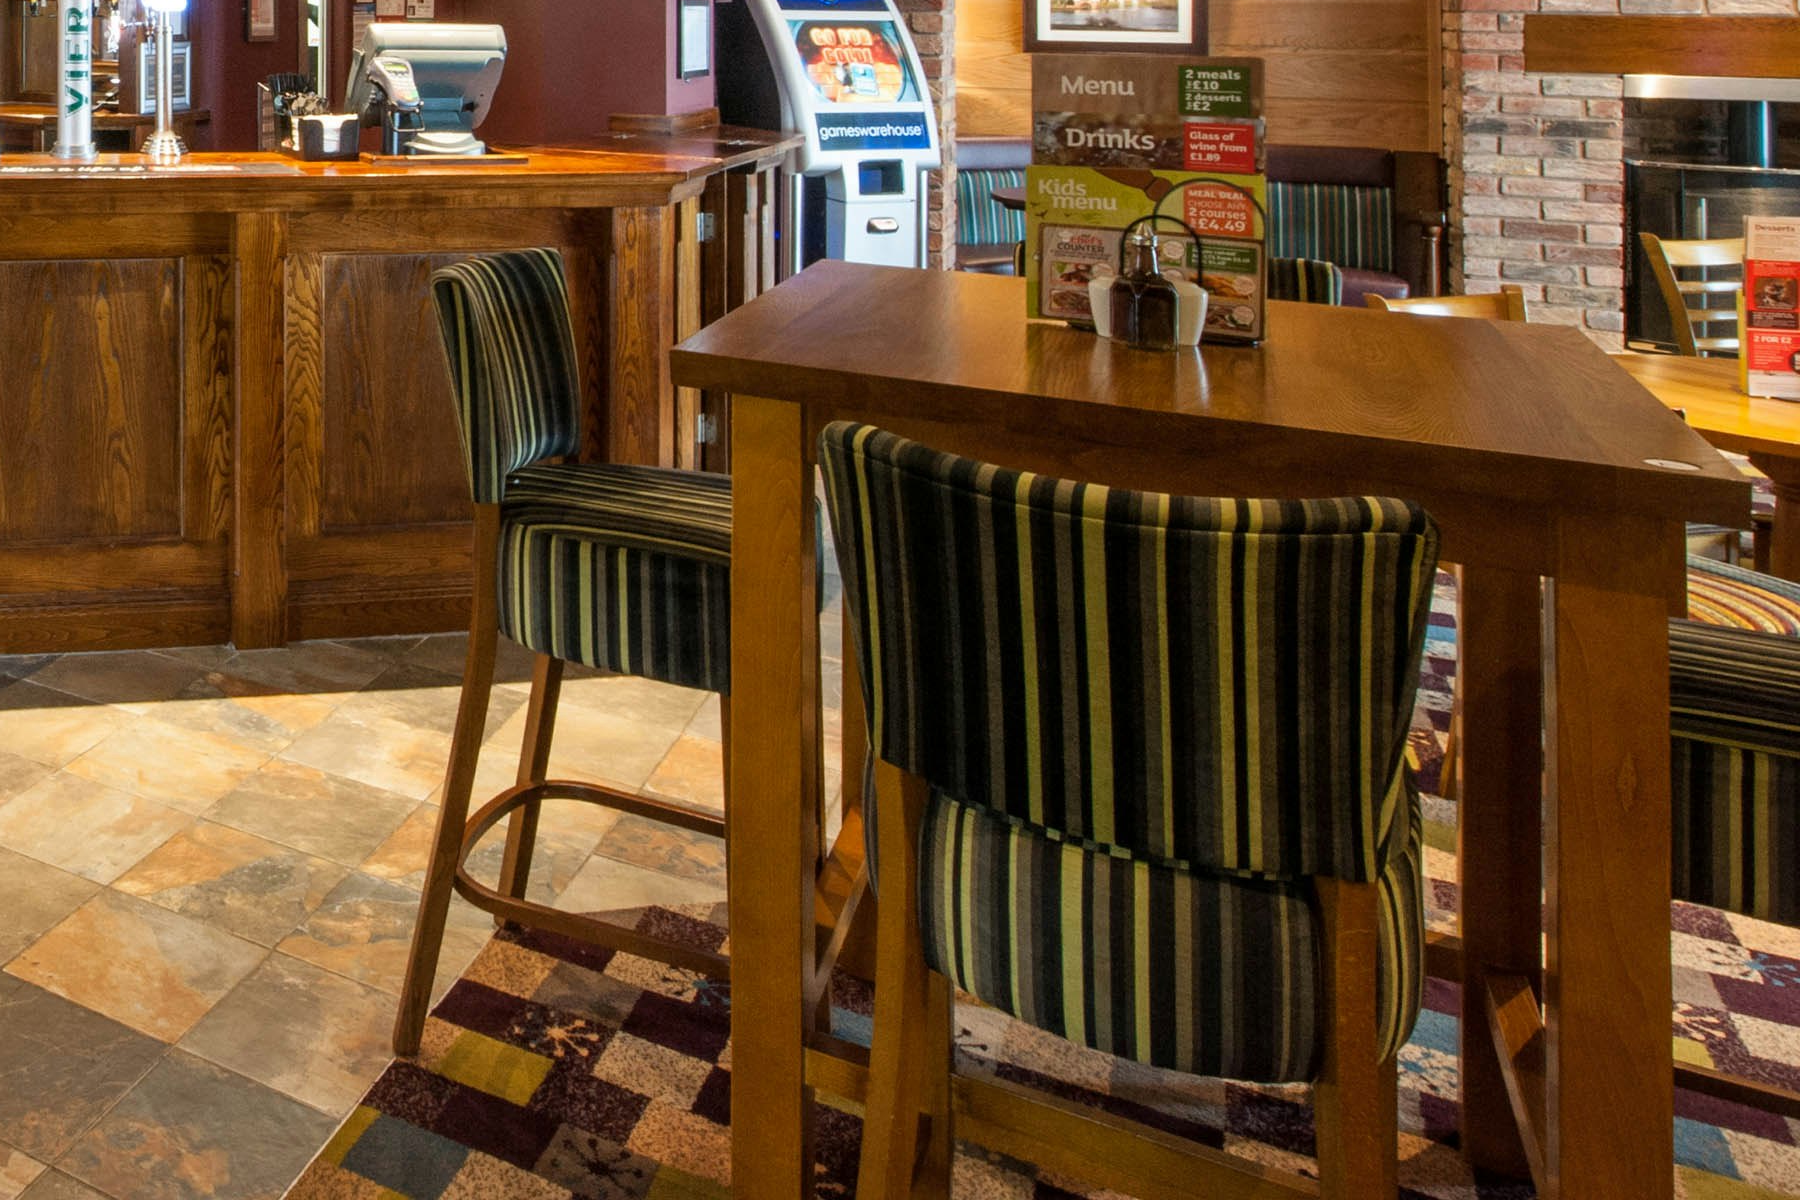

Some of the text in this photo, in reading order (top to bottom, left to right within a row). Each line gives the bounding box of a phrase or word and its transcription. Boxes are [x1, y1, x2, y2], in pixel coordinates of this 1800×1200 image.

[65, 7, 89, 119] VIER
[1185, 69, 1241, 80] 2 meals
[1061, 75, 1135, 96] Menu
[1192, 80, 1219, 90] £10
[1185, 92, 1242, 103] 2 desserts
[1192, 101, 1211, 111] £2
[820, 123, 922, 140] gameswarehouse
[1189, 131, 1235, 142] Glass of
[1065, 128, 1155, 150] Drinks
[1189, 141, 1247, 152] wine from
[1038, 178, 1087, 196] Kids
[1052, 195, 1118, 211] menu
[1188, 207, 1246, 220] 2 courses
[1198, 217, 1246, 233] £4.49
[1754, 224, 1795, 233] Desserts
[1057, 242, 1105, 253] COUNTER
[1761, 335, 1779, 343] FOR
